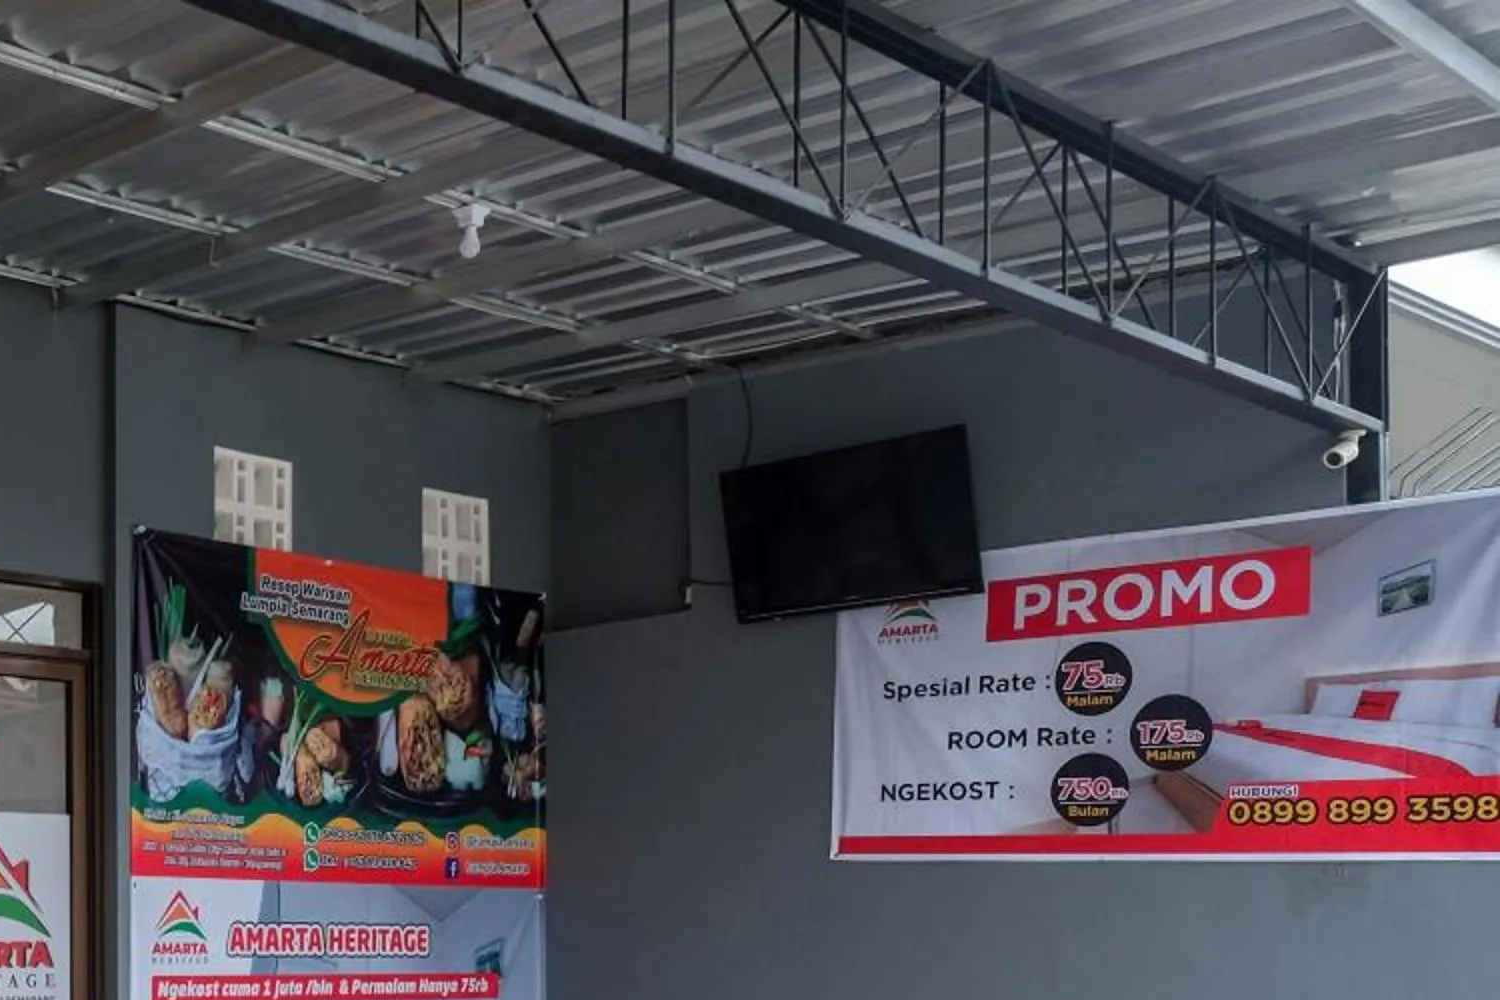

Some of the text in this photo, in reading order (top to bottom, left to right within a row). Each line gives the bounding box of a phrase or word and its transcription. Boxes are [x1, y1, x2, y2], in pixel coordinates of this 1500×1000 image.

[261, 575, 351, 602] Resep Warisan
[1013, 558, 1276, 631] PROMO
[242, 593, 350, 625] Lumpia Semarang
[879, 623, 938, 638] AMARTA
[301, 608, 436, 685] Amarta
[883, 675, 971, 702] Spesial
[979, 673, 1037, 694] Rate
[1067, 694, 1113, 707] Malam
[947, 729, 1027, 751] ROOM
[1037, 727, 1096, 747] Rate
[1146, 750, 1196, 762] Malam
[880, 781, 1000, 803] NGEKOST
[1230, 785, 1298, 798] HUBUNGI
[1067, 805, 1109, 818] Bulan
[1228, 795, 1500, 826] 0899 899 3598
[152, 941, 209, 955] AMARTA
[230, 926, 428, 954] AMARTA HERITAGE
[157, 980, 219, 1000] Ngekost
[222, 983, 260, 997] cuma
[263, 981, 271, 995] 1
[273, 980, 302, 998] juta
[339, 980, 349, 994] &
[351, 979, 417, 995] Permalam
[419, 978, 458, 998] Hanya
[461, 977, 489, 994] 75rb
